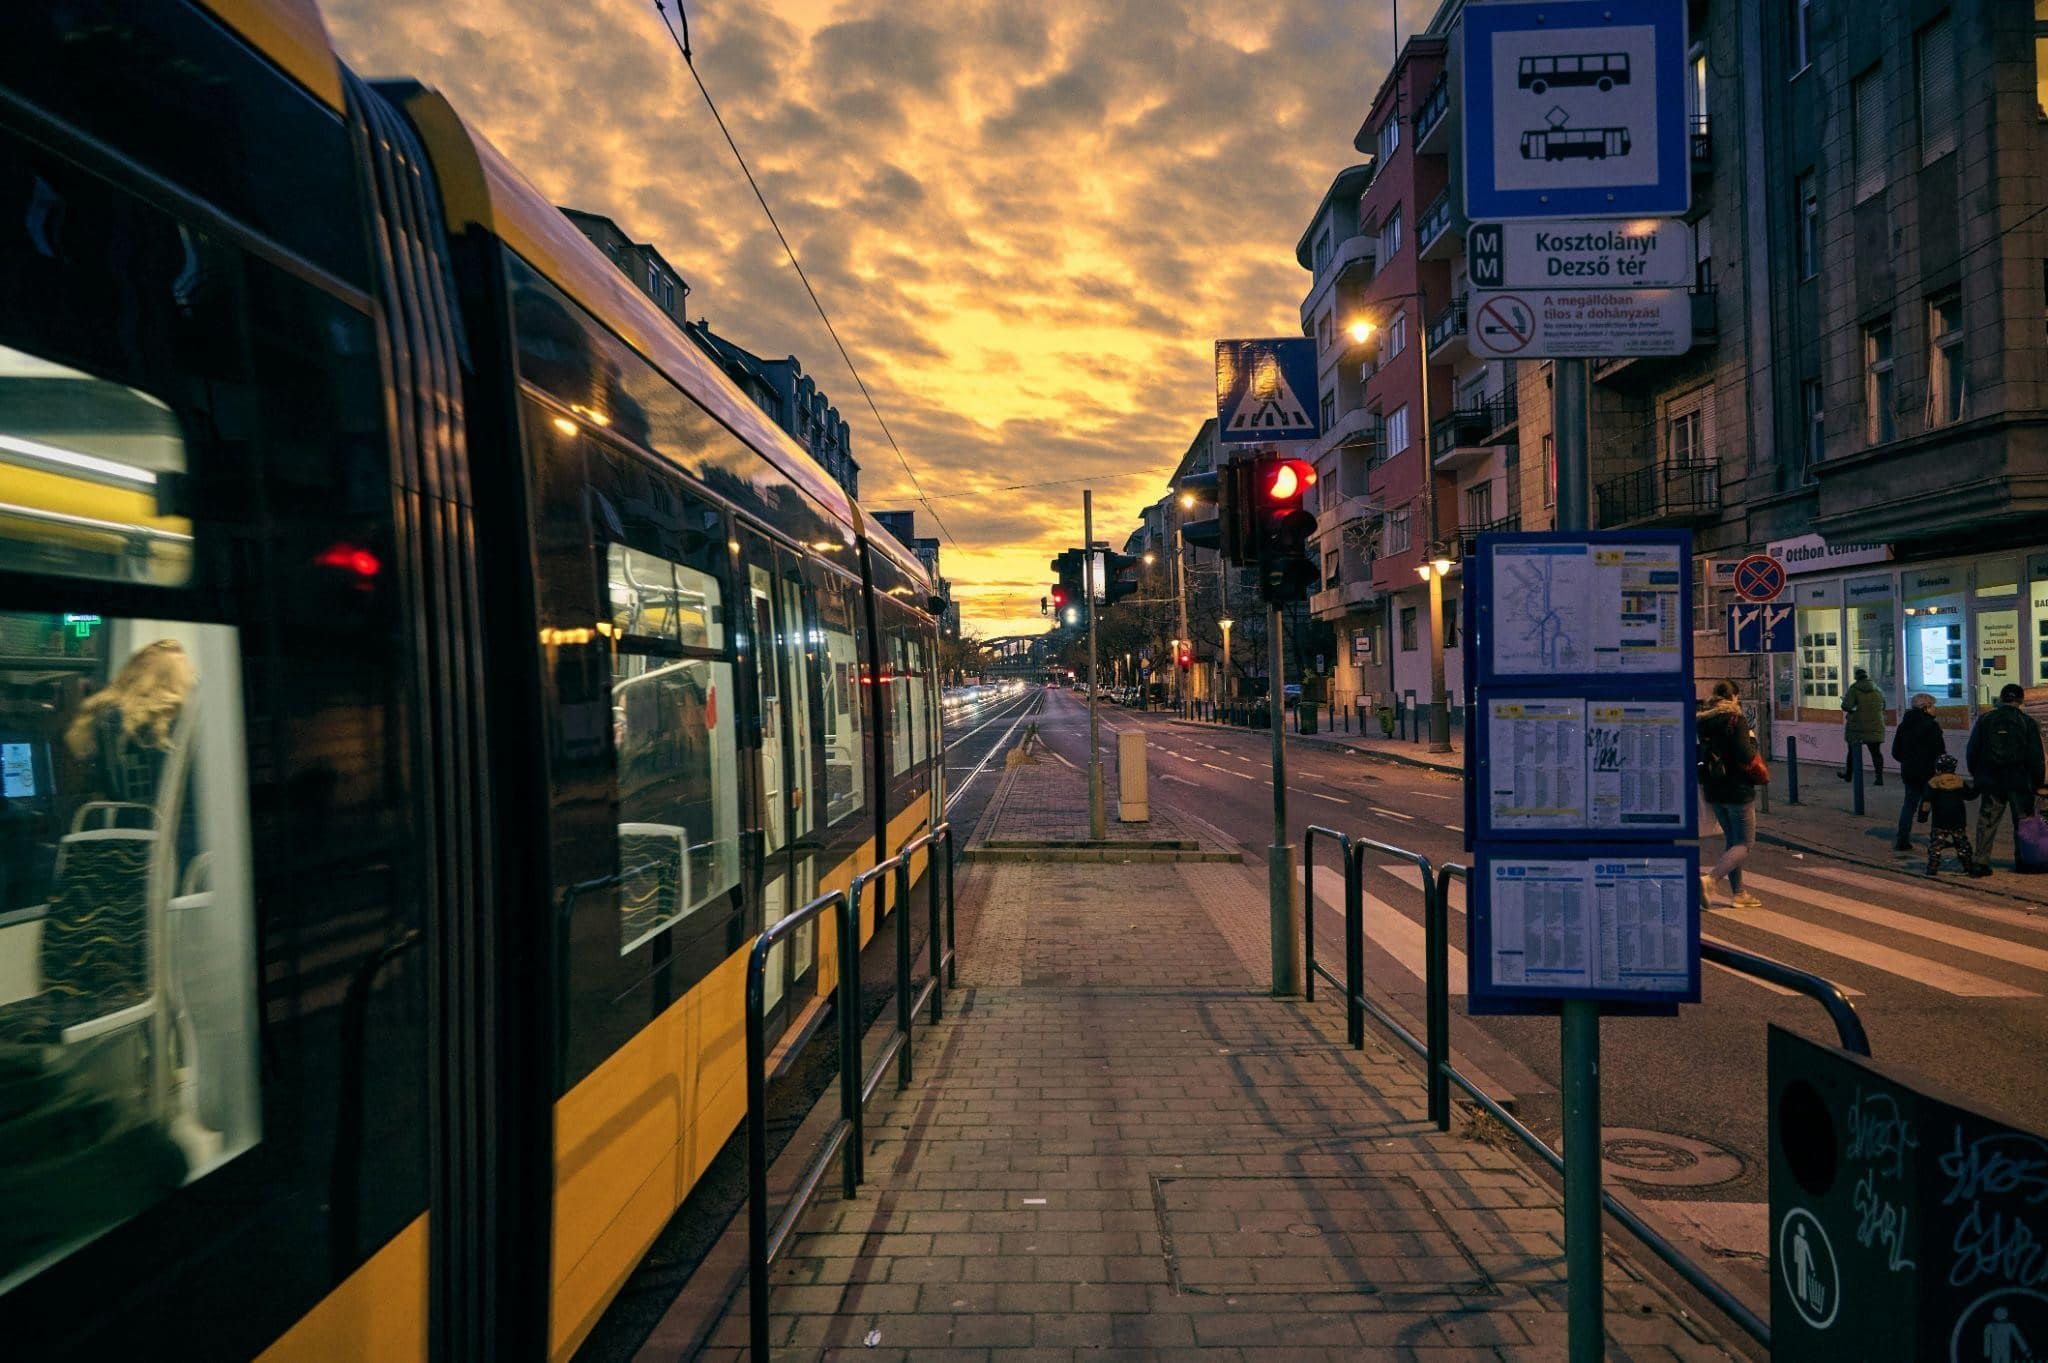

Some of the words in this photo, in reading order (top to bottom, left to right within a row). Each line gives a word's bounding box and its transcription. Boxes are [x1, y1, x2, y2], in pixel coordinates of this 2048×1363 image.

[1476, 232, 1497, 254] M
[1536, 230, 1657, 256] Kosztolányi
[1476, 257, 1498, 279] M
[1547, 256, 1610, 276] Dezső
[1618, 256, 1646, 275] tér
[1543, 295, 1554, 306] A
[1557, 294, 1633, 309] megállóban
[1543, 308, 1571, 320] tilos
[1575, 311, 1584, 320] a
[1587, 307, 1660, 322] dohányzás!
[1786, 545, 1824, 562] Otthon
